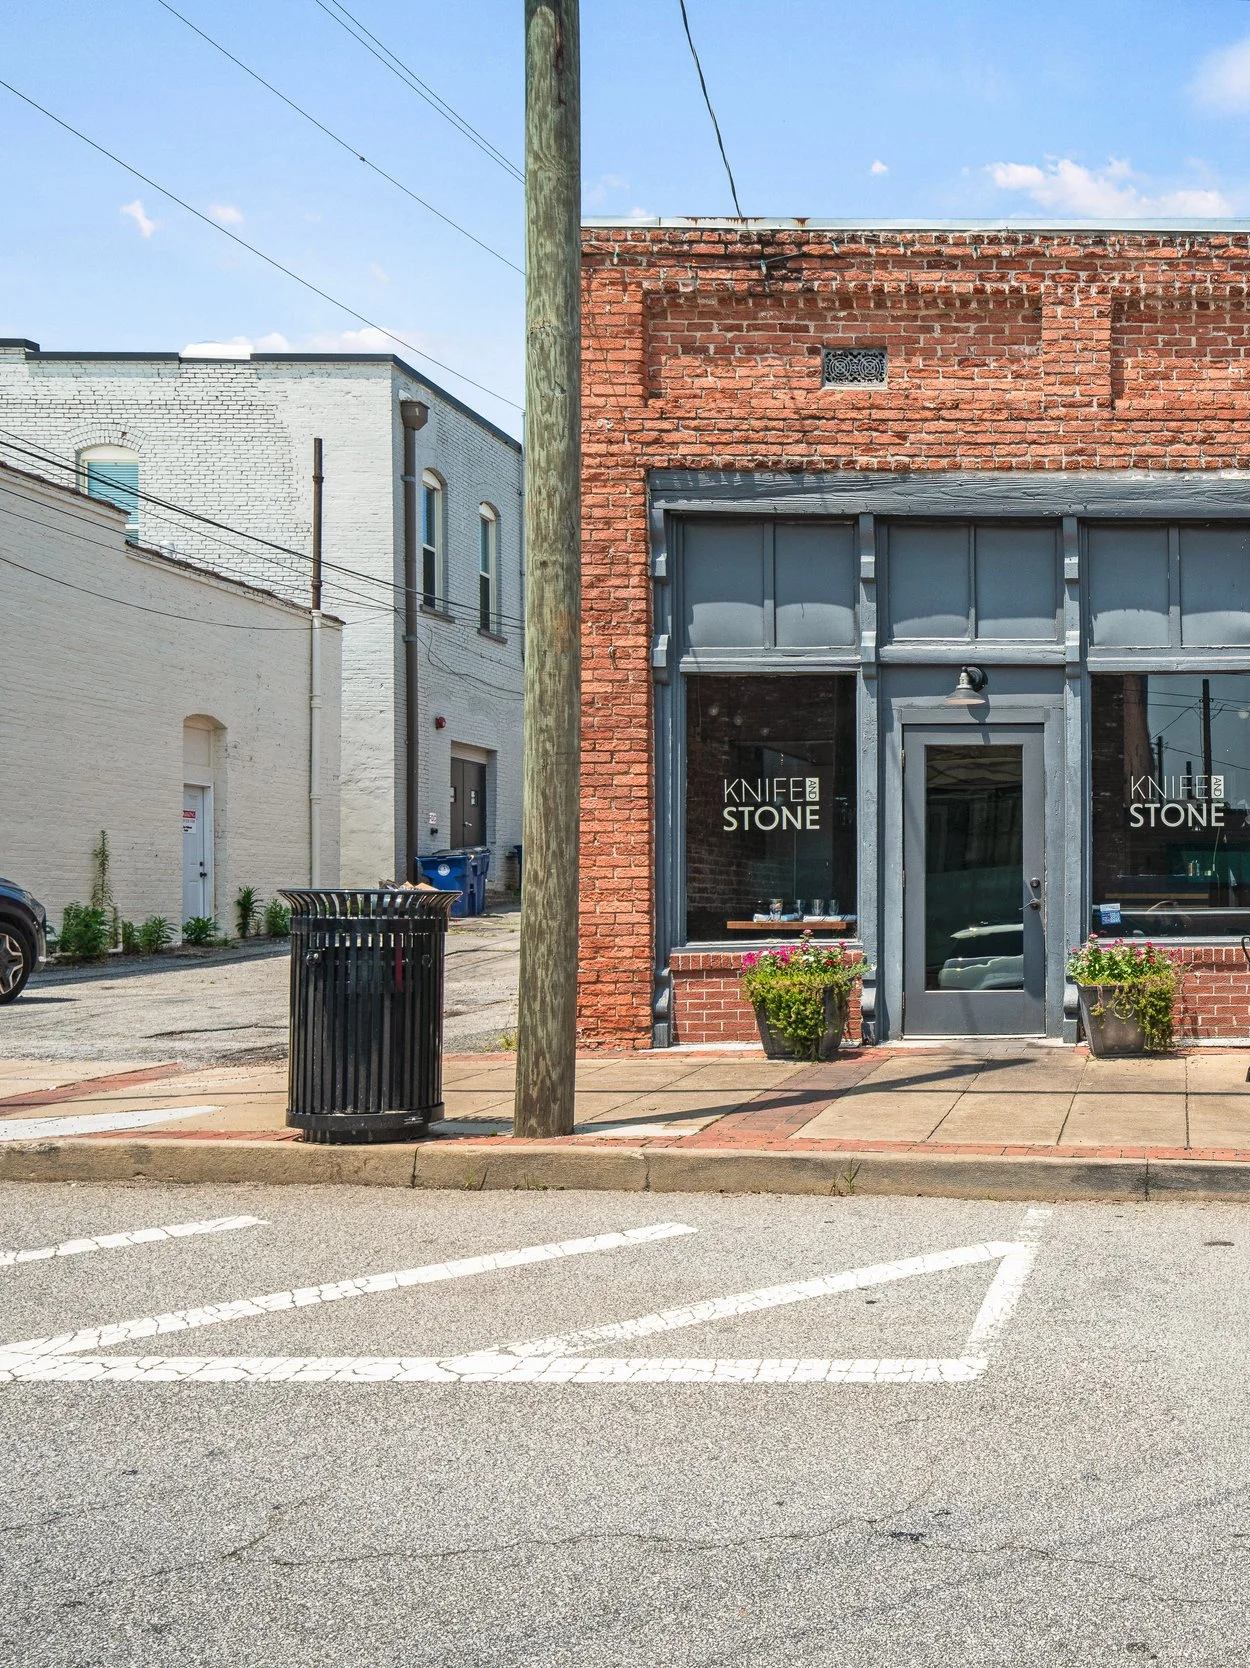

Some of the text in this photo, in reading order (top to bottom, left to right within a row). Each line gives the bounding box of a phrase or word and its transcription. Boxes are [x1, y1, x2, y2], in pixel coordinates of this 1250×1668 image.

[724, 777, 818, 803] KNIFE AND
[1131, 775, 1223, 800] KNIFE AND
[723, 806, 820, 832] STONE
[1130, 803, 1225, 828] STONE
